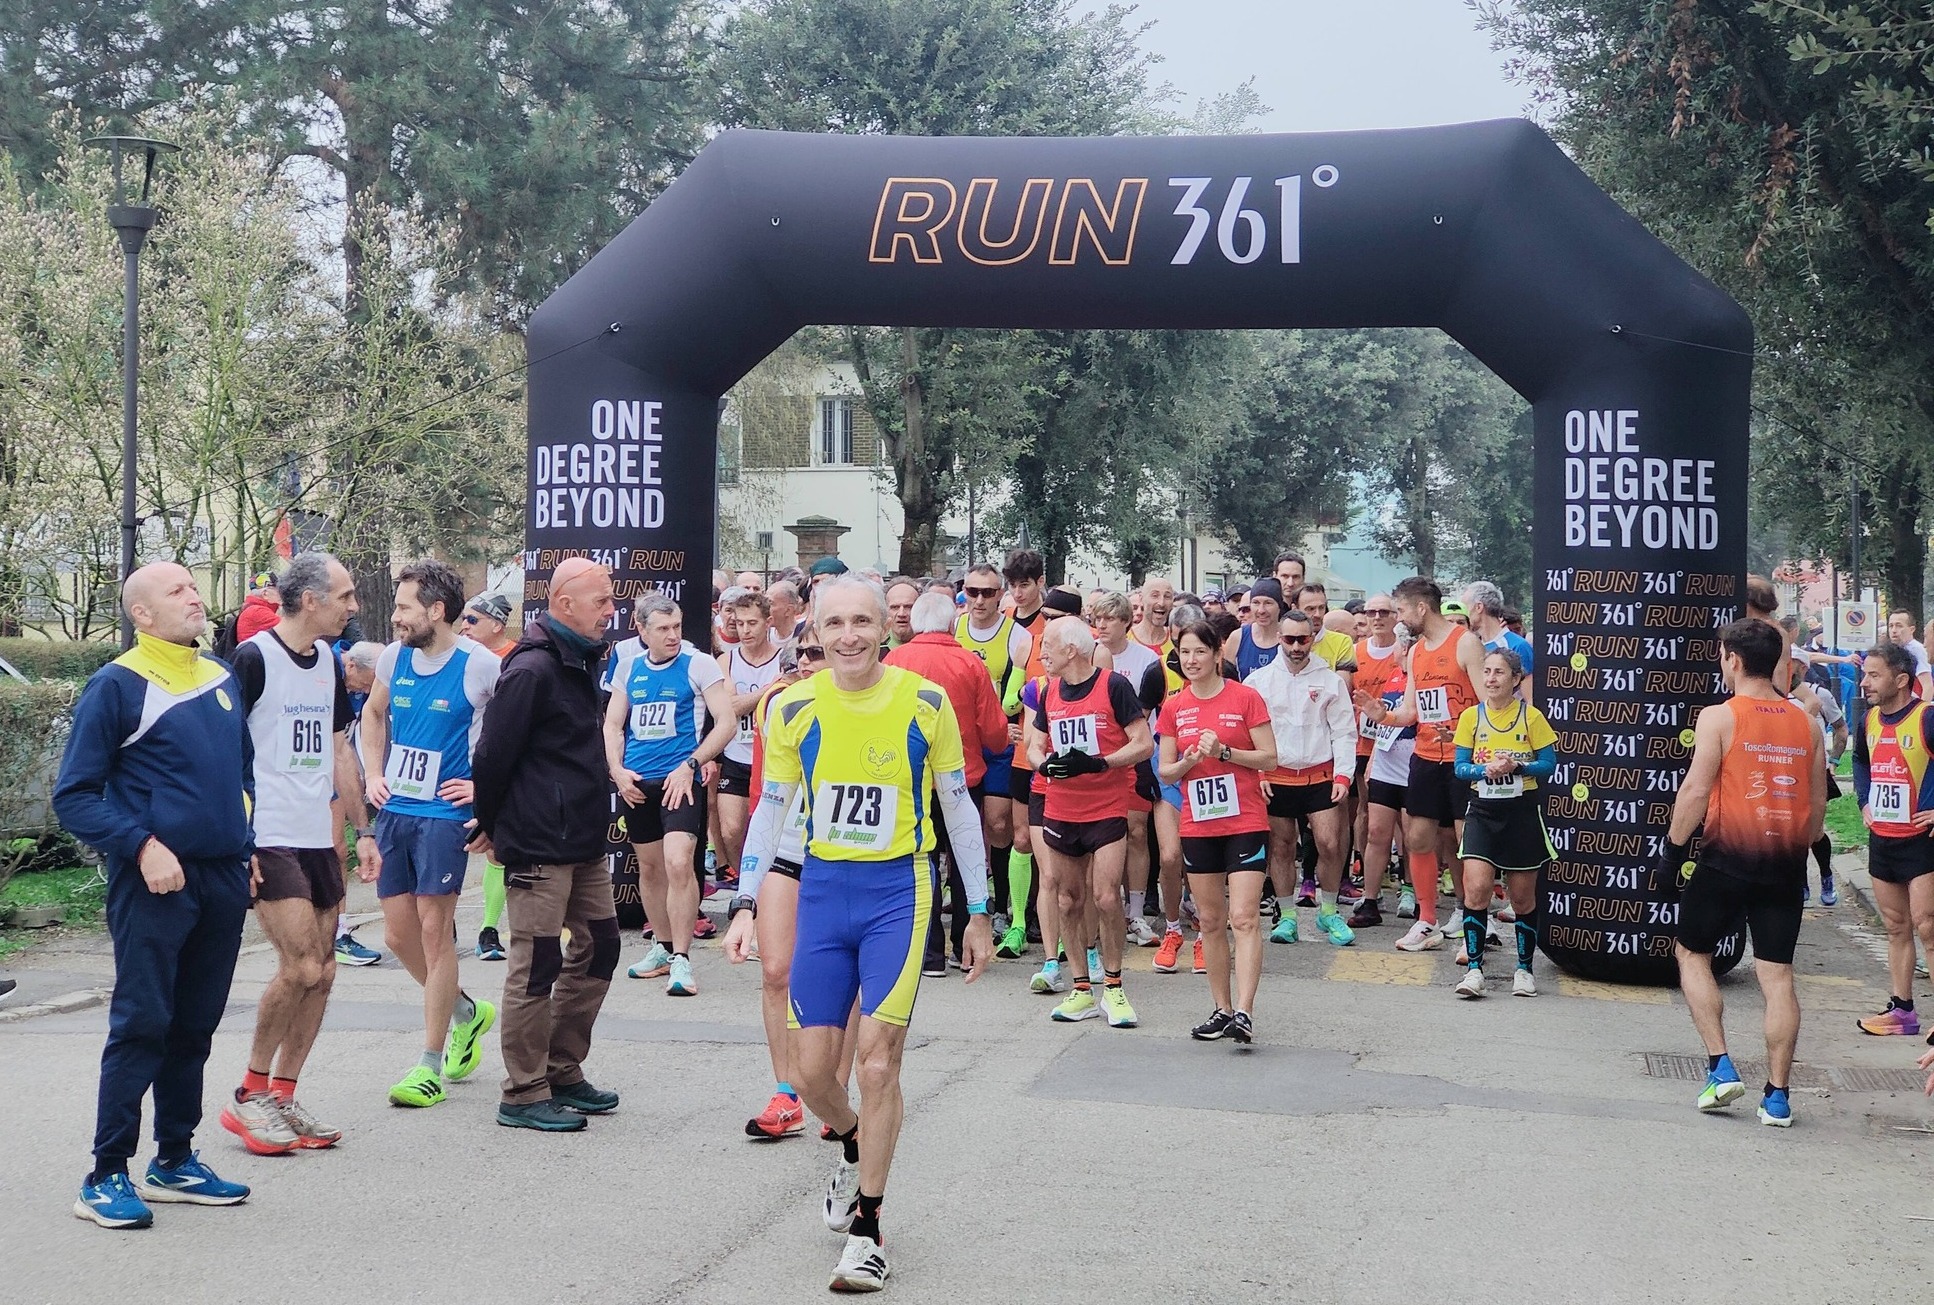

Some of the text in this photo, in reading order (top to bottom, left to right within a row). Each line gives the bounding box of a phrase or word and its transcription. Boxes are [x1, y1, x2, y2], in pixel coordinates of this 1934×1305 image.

[868, 164, 1340, 266] RUN 361°
[591, 399, 663, 442] ONE
[1564, 409, 1640, 454] ONE
[536, 443, 663, 486] DEGREE
[1564, 456, 1716, 503] DEGREE
[535, 486, 665, 529] BEYOND
[1565, 503, 1719, 551] BEYOND
[629, 549, 684, 571] RUN
[1546, 567, 1736, 596] 361° RUN 361° RUN
[1546, 602, 1597, 624] RUN
[1600, 602, 1642, 626] 361°
[1644, 605, 1709, 628] RUN
[1546, 632, 1722, 661] 361° RUN 361° RU
[1546, 665, 1598, 690] RUN
[1601, 667, 1643, 692] 361°
[1645, 671, 1709, 694] RUN
[1418, 689, 1440, 711] 527
[1547, 697, 1575, 721] 361°
[1575, 700, 1640, 724] RUN
[1644, 702, 1686, 726] 361°
[1755, 705, 1786, 715] ITALIA
[638, 703, 667, 727] 622
[293, 719, 322, 754] 616
[1058, 717, 1088, 745] 674
[1602, 733, 1645, 758] 361°
[1646, 737, 1696, 760] RU
[1758, 754, 1793, 765] RUNNER
[397, 748, 429, 782] 713
[1576, 765, 1641, 790] RUN
[1645, 767, 1686, 792] 361°
[830, 784, 883, 827] 723
[1195, 777, 1228, 806] 675
[1875, 784, 1900, 809] 735
[1547, 795, 1600, 821] RUN
[1603, 800, 1645, 823] 361°
[1576, 831, 1641, 857] RUN
[1548, 860, 1601, 887] RUN
[1604, 865, 1646, 890] 361°
[1547, 892, 1680, 925] 361° RUN 361
[1549, 924, 1602, 952] RUN
[1605, 932, 1647, 955] 361°
